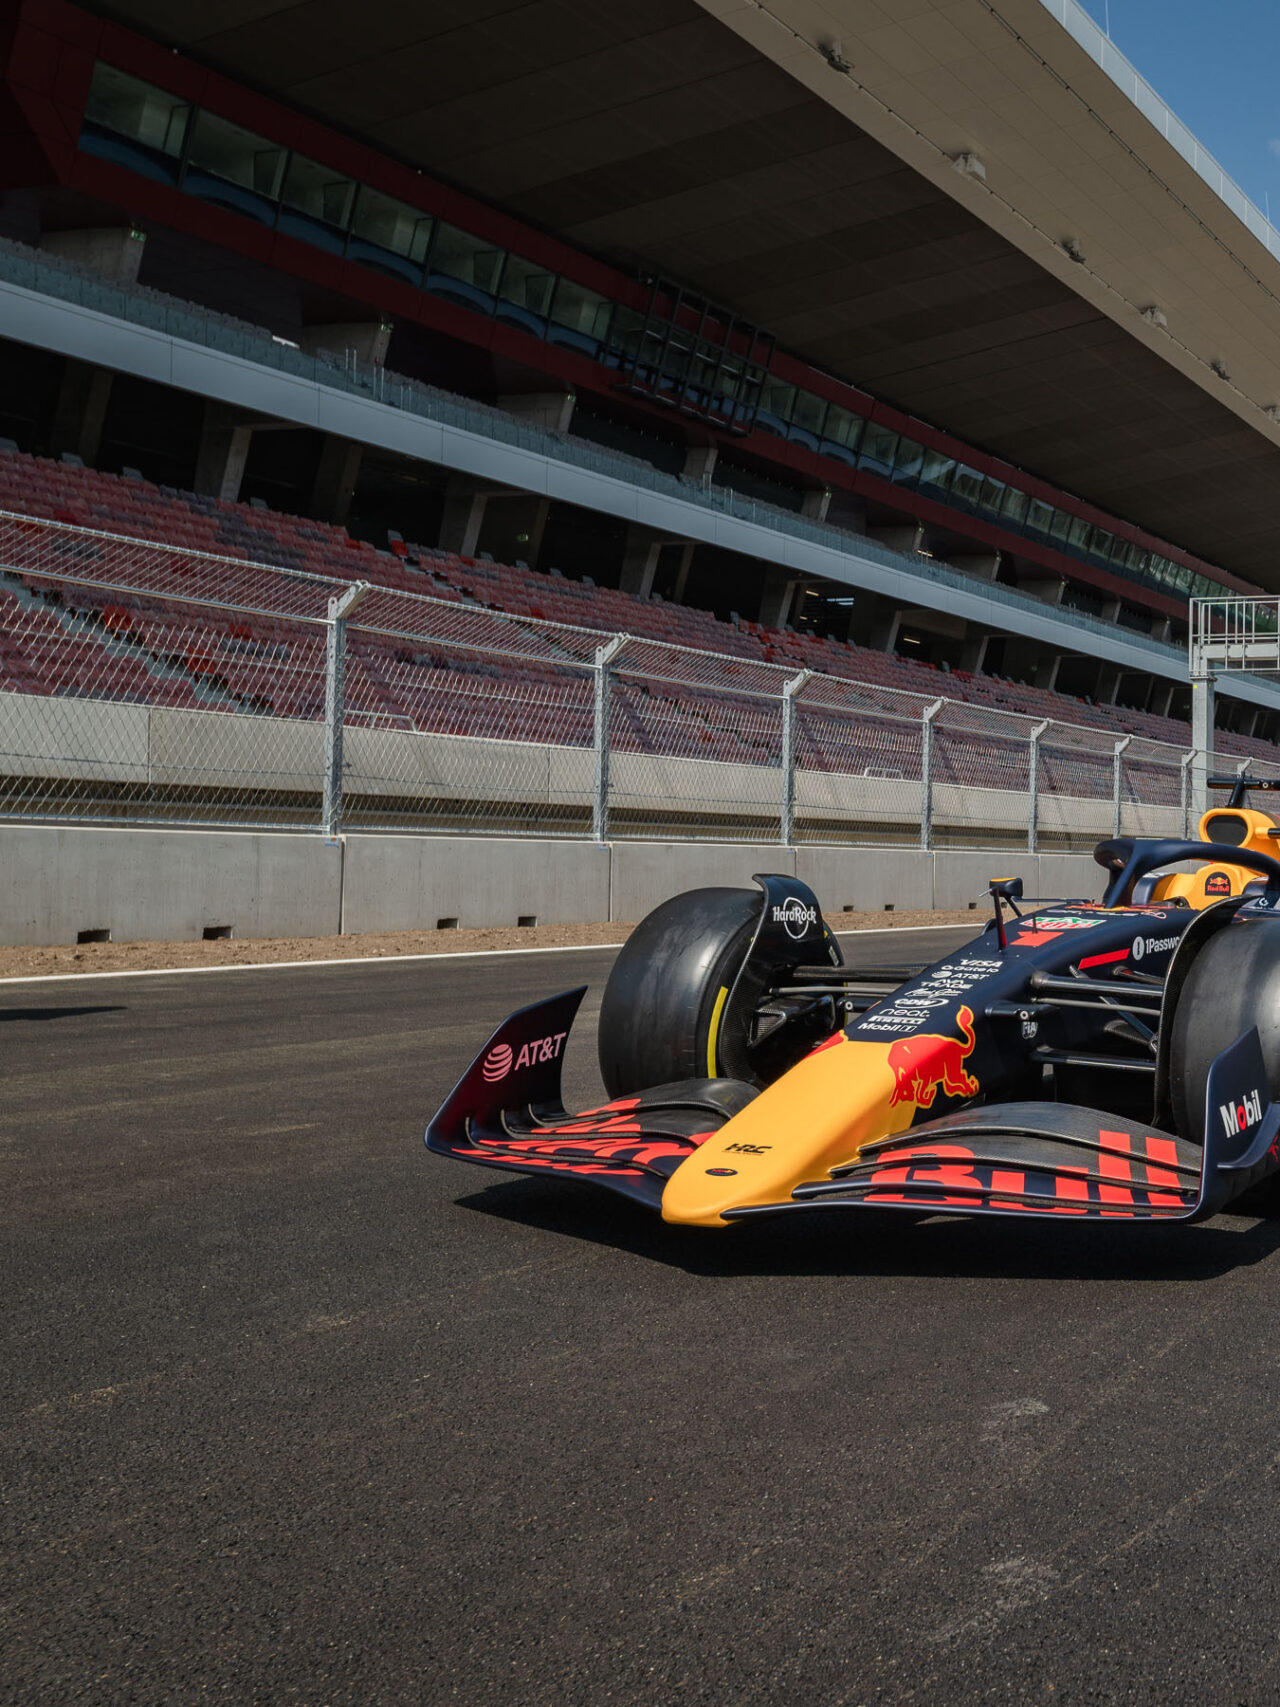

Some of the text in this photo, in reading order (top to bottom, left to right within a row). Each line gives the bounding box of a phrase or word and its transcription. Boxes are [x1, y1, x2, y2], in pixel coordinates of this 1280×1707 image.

[960, 958, 1003, 968] VISA
[950, 973, 990, 981] AT&T
[857, 1022, 901, 1032] Mobil
[514, 1031, 567, 1072] AT&T
[1219, 1088, 1263, 1139] Mobil
[725, 1143, 773, 1154] HRC
[863, 1129, 1185, 1217] Bull
